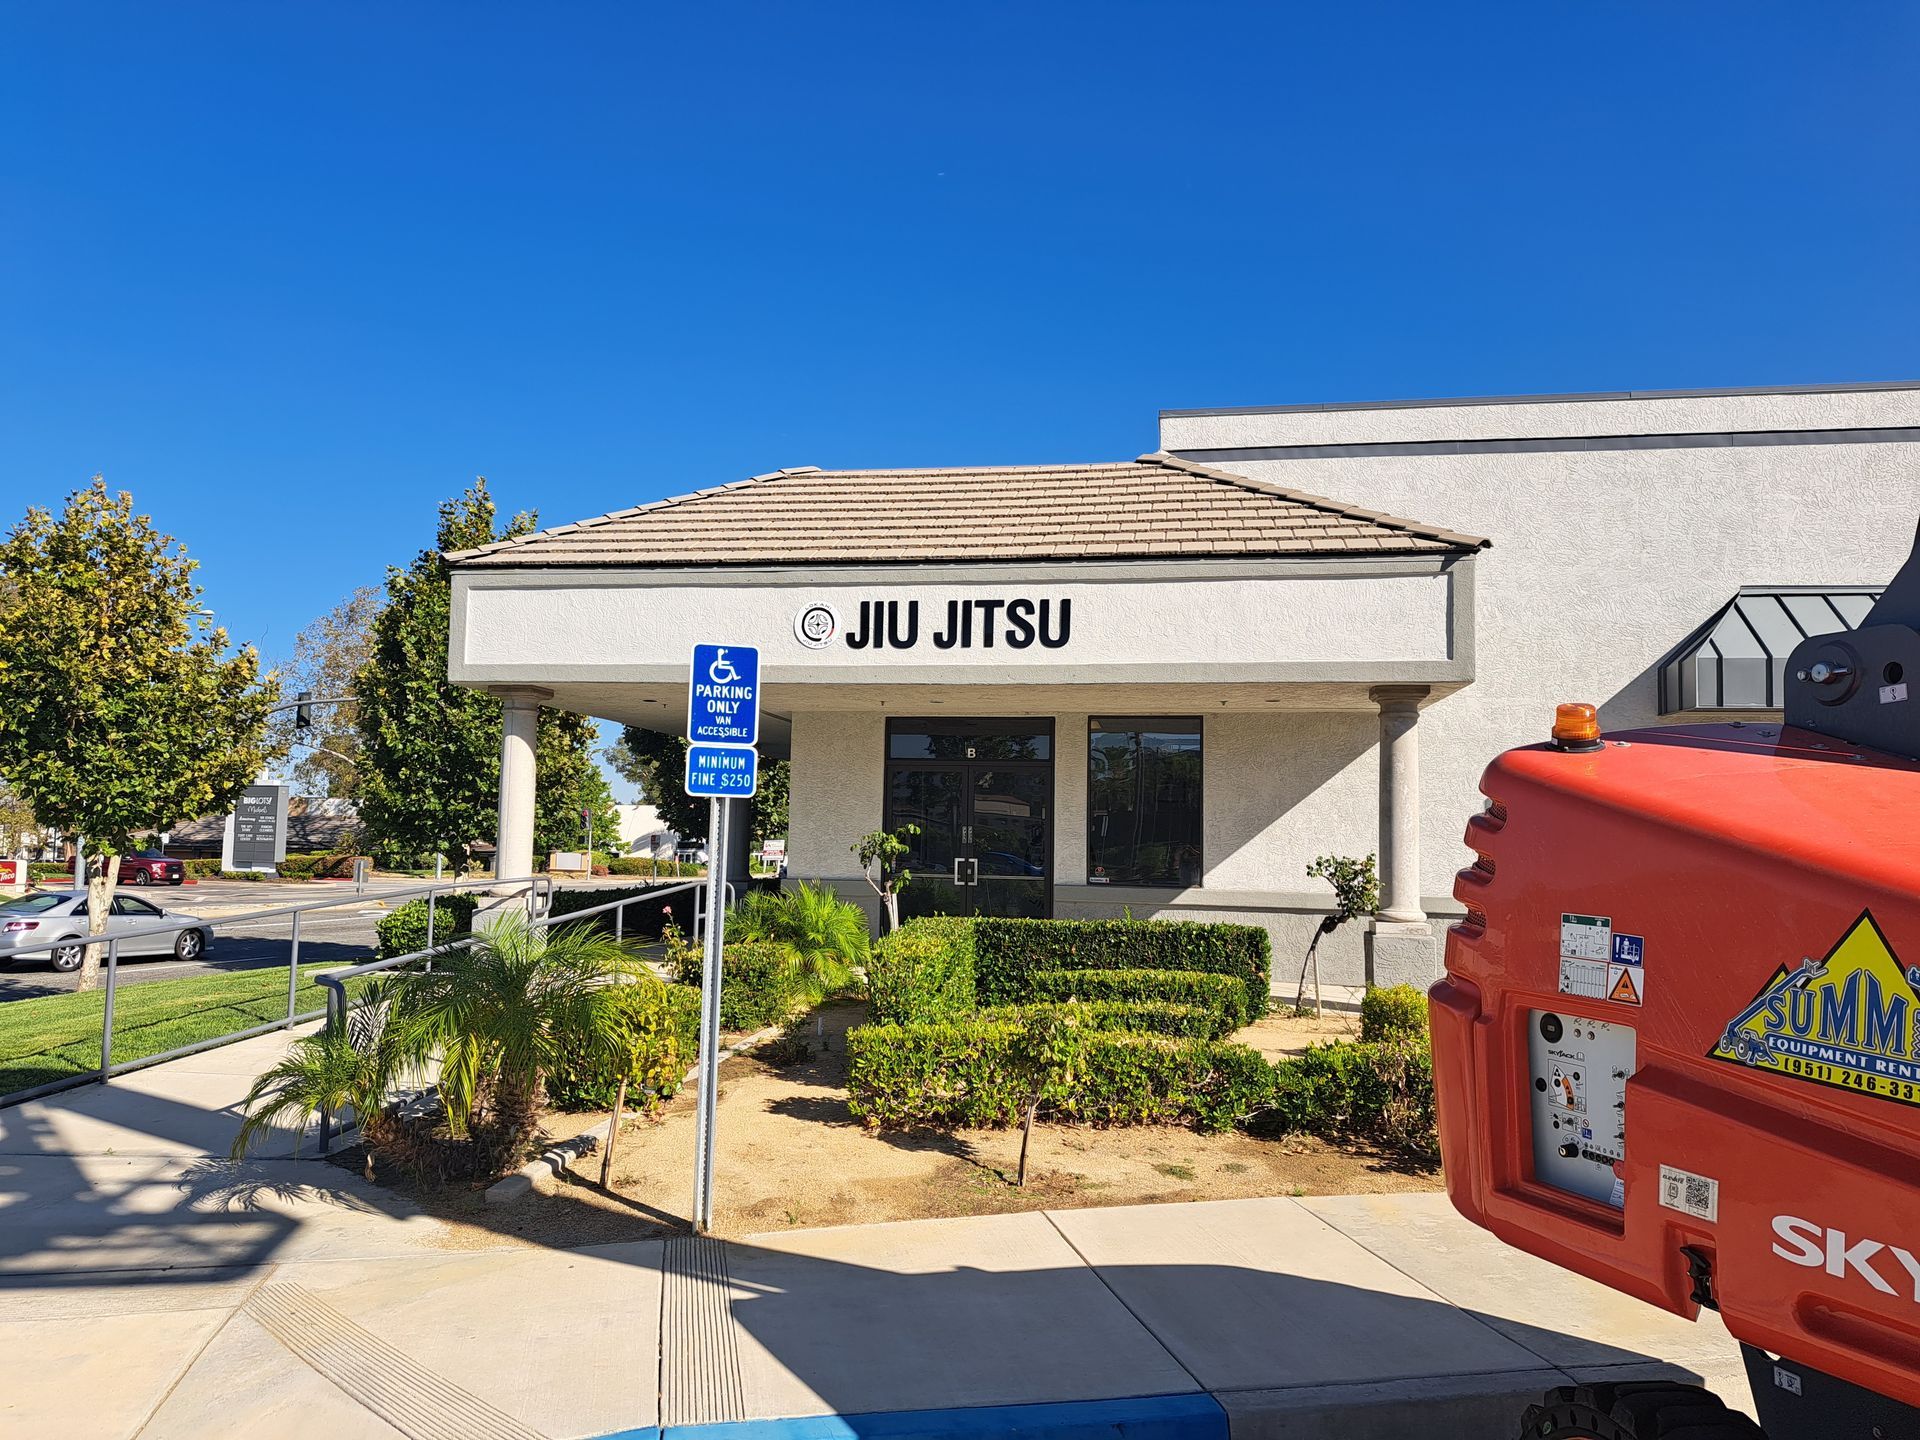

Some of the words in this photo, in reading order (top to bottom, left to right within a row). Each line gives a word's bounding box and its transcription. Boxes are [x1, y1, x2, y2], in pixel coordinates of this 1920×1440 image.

[845, 600, 918, 649] JIU
[933, 599, 1071, 649] JITSU
[696, 684, 752, 700] PARKING
[707, 699, 740, 714] ONLY
[715, 715, 732, 725] VAN
[697, 726, 748, 737] ACCESSIBLE
[967, 748, 976, 758] B
[698, 755, 746, 770] MINIMUM
[691, 772, 716, 786] FINE
[721, 773, 751, 787] $250
[1768, 1036, 1869, 1068] EQUIPMENT
[1784, 1058, 1832, 1080] (951)
[1842, 1070, 1920, 1099] 246-33
